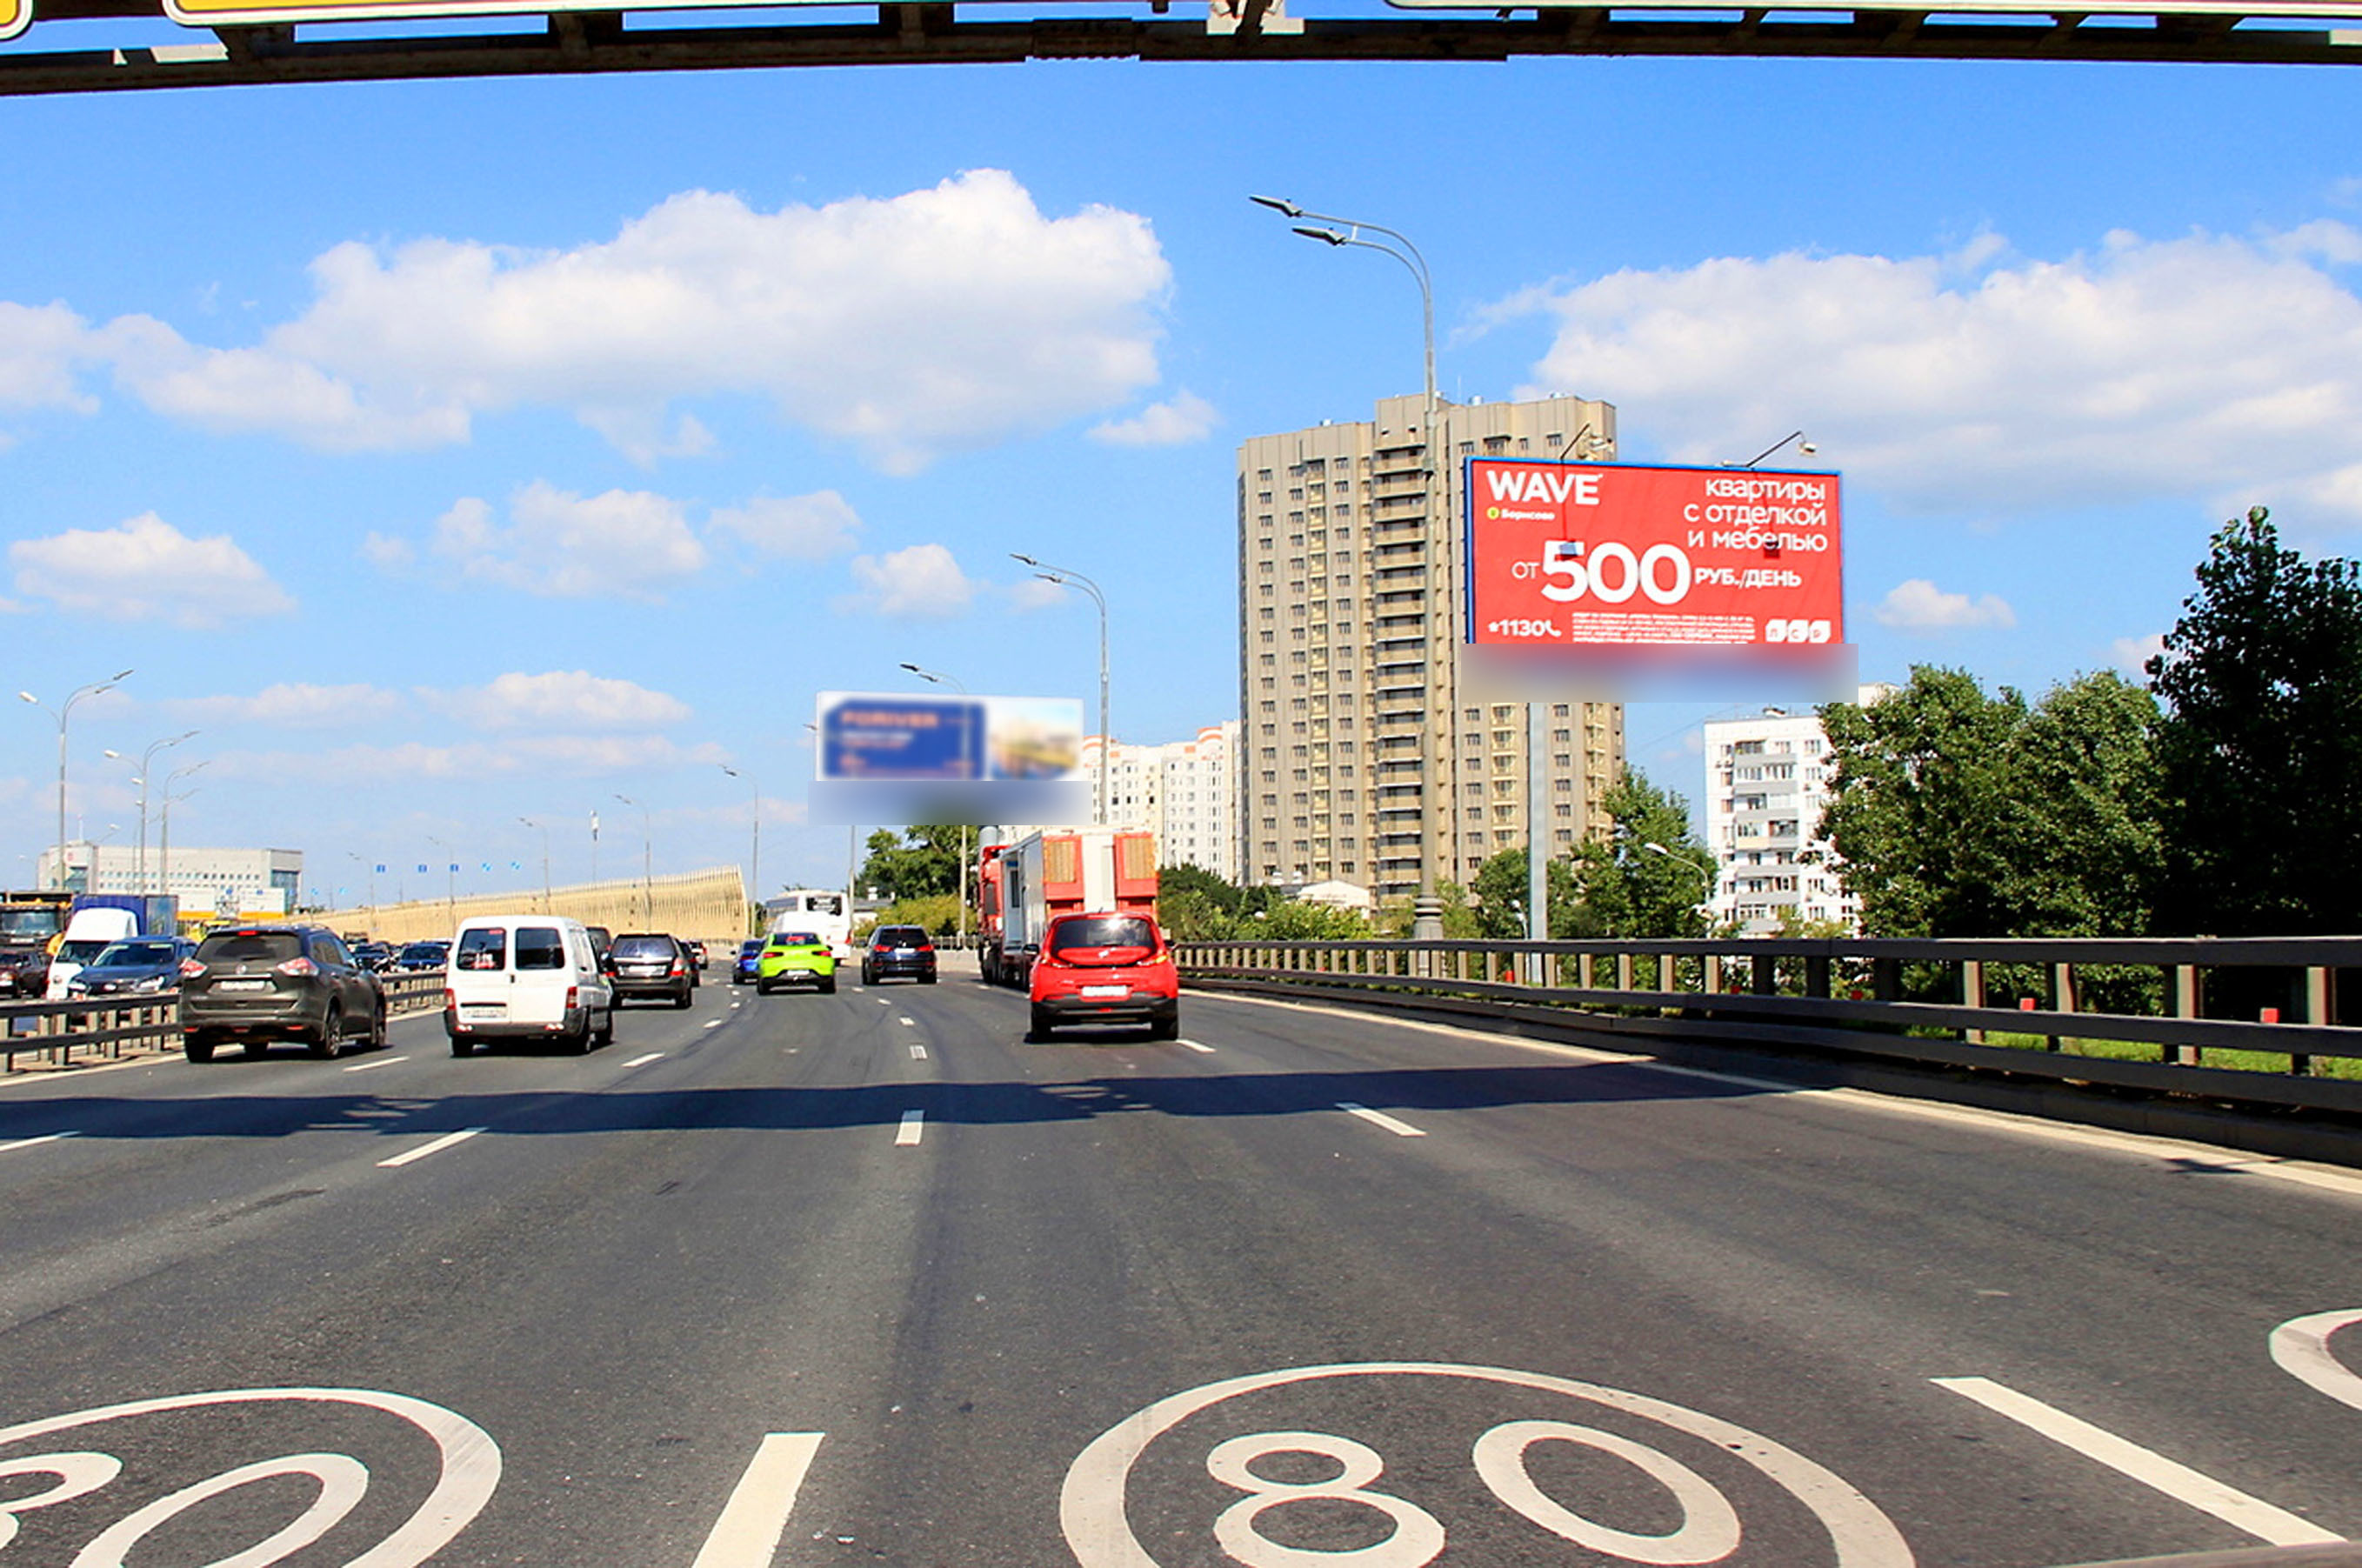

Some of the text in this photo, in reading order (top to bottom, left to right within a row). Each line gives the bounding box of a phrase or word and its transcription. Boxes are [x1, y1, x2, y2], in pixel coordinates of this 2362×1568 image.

[1486, 470, 1603, 504] WAVE
[1705, 479, 1825, 504] квартиры
[1684, 503, 1827, 526] с отделкой
[1688, 526, 1828, 551] и мебелью
[1541, 540, 1691, 604] 500
[1206, 1419, 1742, 1568] 80
